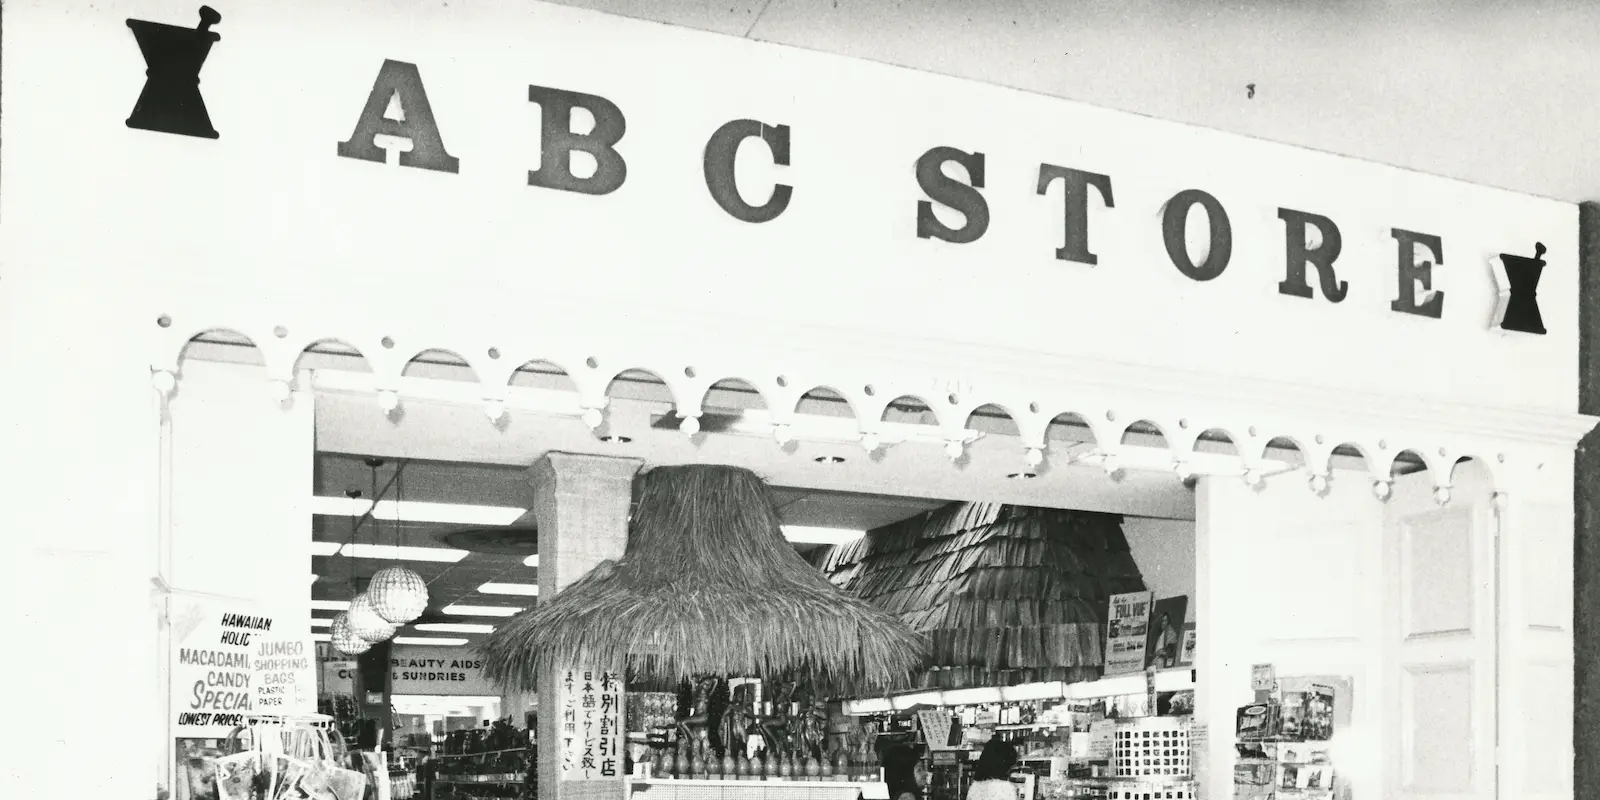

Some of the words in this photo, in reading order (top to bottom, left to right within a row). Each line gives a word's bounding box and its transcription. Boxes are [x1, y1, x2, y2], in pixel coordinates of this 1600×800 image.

[337, 58, 793, 223] ABC
[914, 145, 1446, 319] STORE
[221, 612, 272, 631] HAWAIIAN
[220, 630, 262, 647] HOLID
[258, 641, 303, 656] JUMBO
[180, 648, 251, 669] MACADAMI
[254, 658, 308, 671] SHOPPING
[450, 660, 481, 670] AIDS
[207, 671, 251, 688] CANDY
[264, 672, 295, 685] BAGS
[402, 671, 466, 682] SUNDRIES
[258, 686, 285, 695] PLASTIC
[258, 697, 282, 706] PAPER
[178, 712, 211, 726] LOWEST
